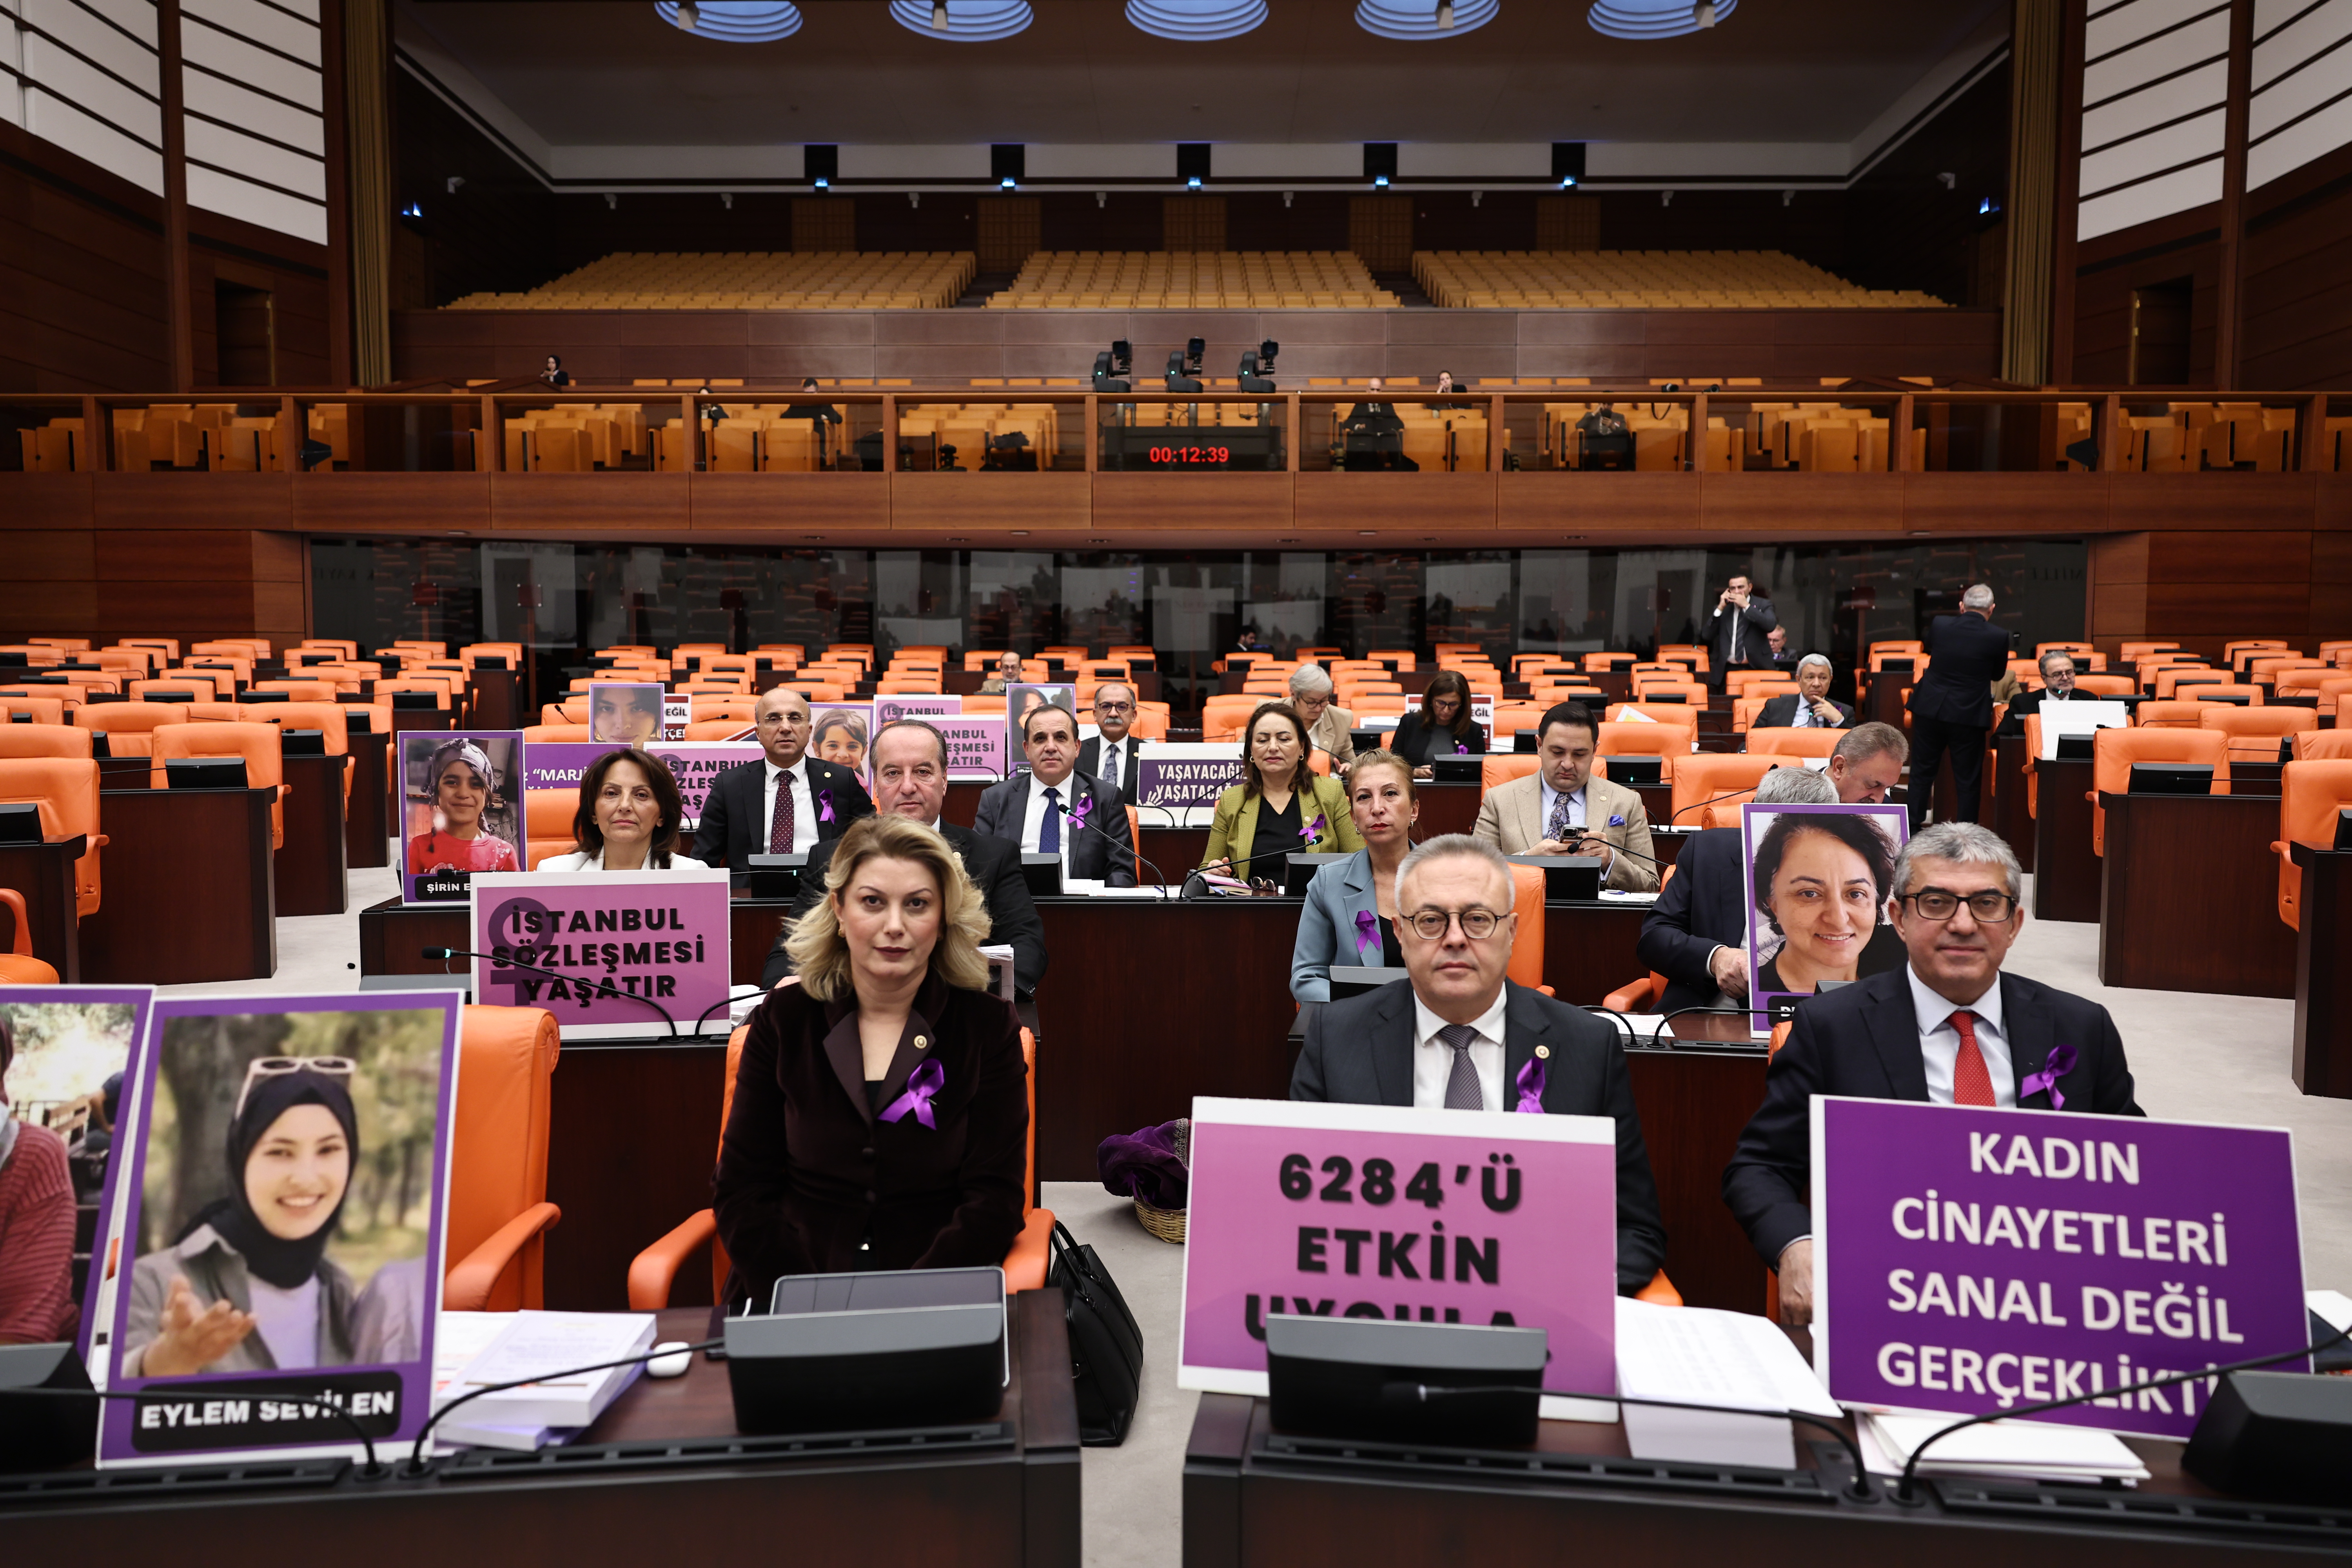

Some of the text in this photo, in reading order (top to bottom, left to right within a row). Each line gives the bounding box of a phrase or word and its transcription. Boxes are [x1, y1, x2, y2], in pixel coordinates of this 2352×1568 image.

[1150, 446, 1229, 463] 00:12:39
[664, 706, 688, 717] EĞİL
[942, 730, 987, 739] ANBUL
[946, 740, 995, 755] EŞMESİ
[947, 756, 983, 765] ATIR
[426, 881, 460, 894] ŞİRİN
[512, 905, 685, 934] İSTANBUL
[491, 934, 705, 973] SÖZLEŞMESİ
[521, 974, 677, 1008] YAŞATIR
[1969, 1131, 2140, 1185] KADIN
[1892, 1189, 2229, 1267] CİNAYETLERİ
[1297, 1220, 1500, 1285] ETKİN
[1887, 1269, 2244, 1345] SANAL DEĞİL
[141, 1400, 250, 1430] EYLEM
